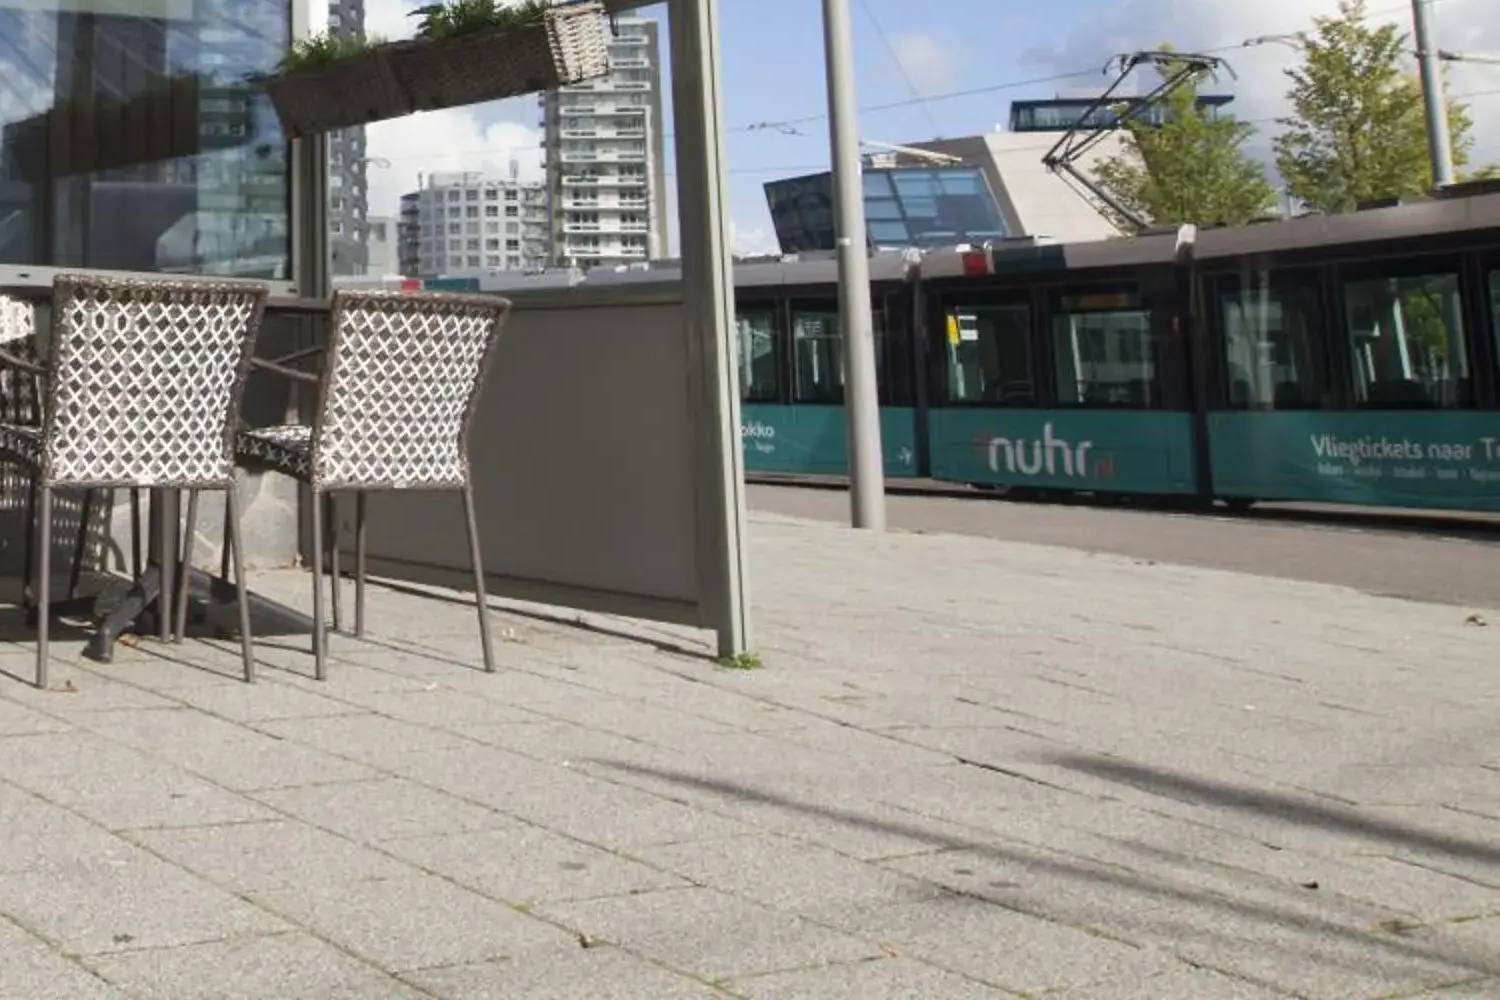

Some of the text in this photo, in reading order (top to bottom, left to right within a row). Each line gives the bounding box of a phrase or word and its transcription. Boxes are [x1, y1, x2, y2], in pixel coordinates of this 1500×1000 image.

[1310, 433, 1500, 466] Vliegtickets naar T
